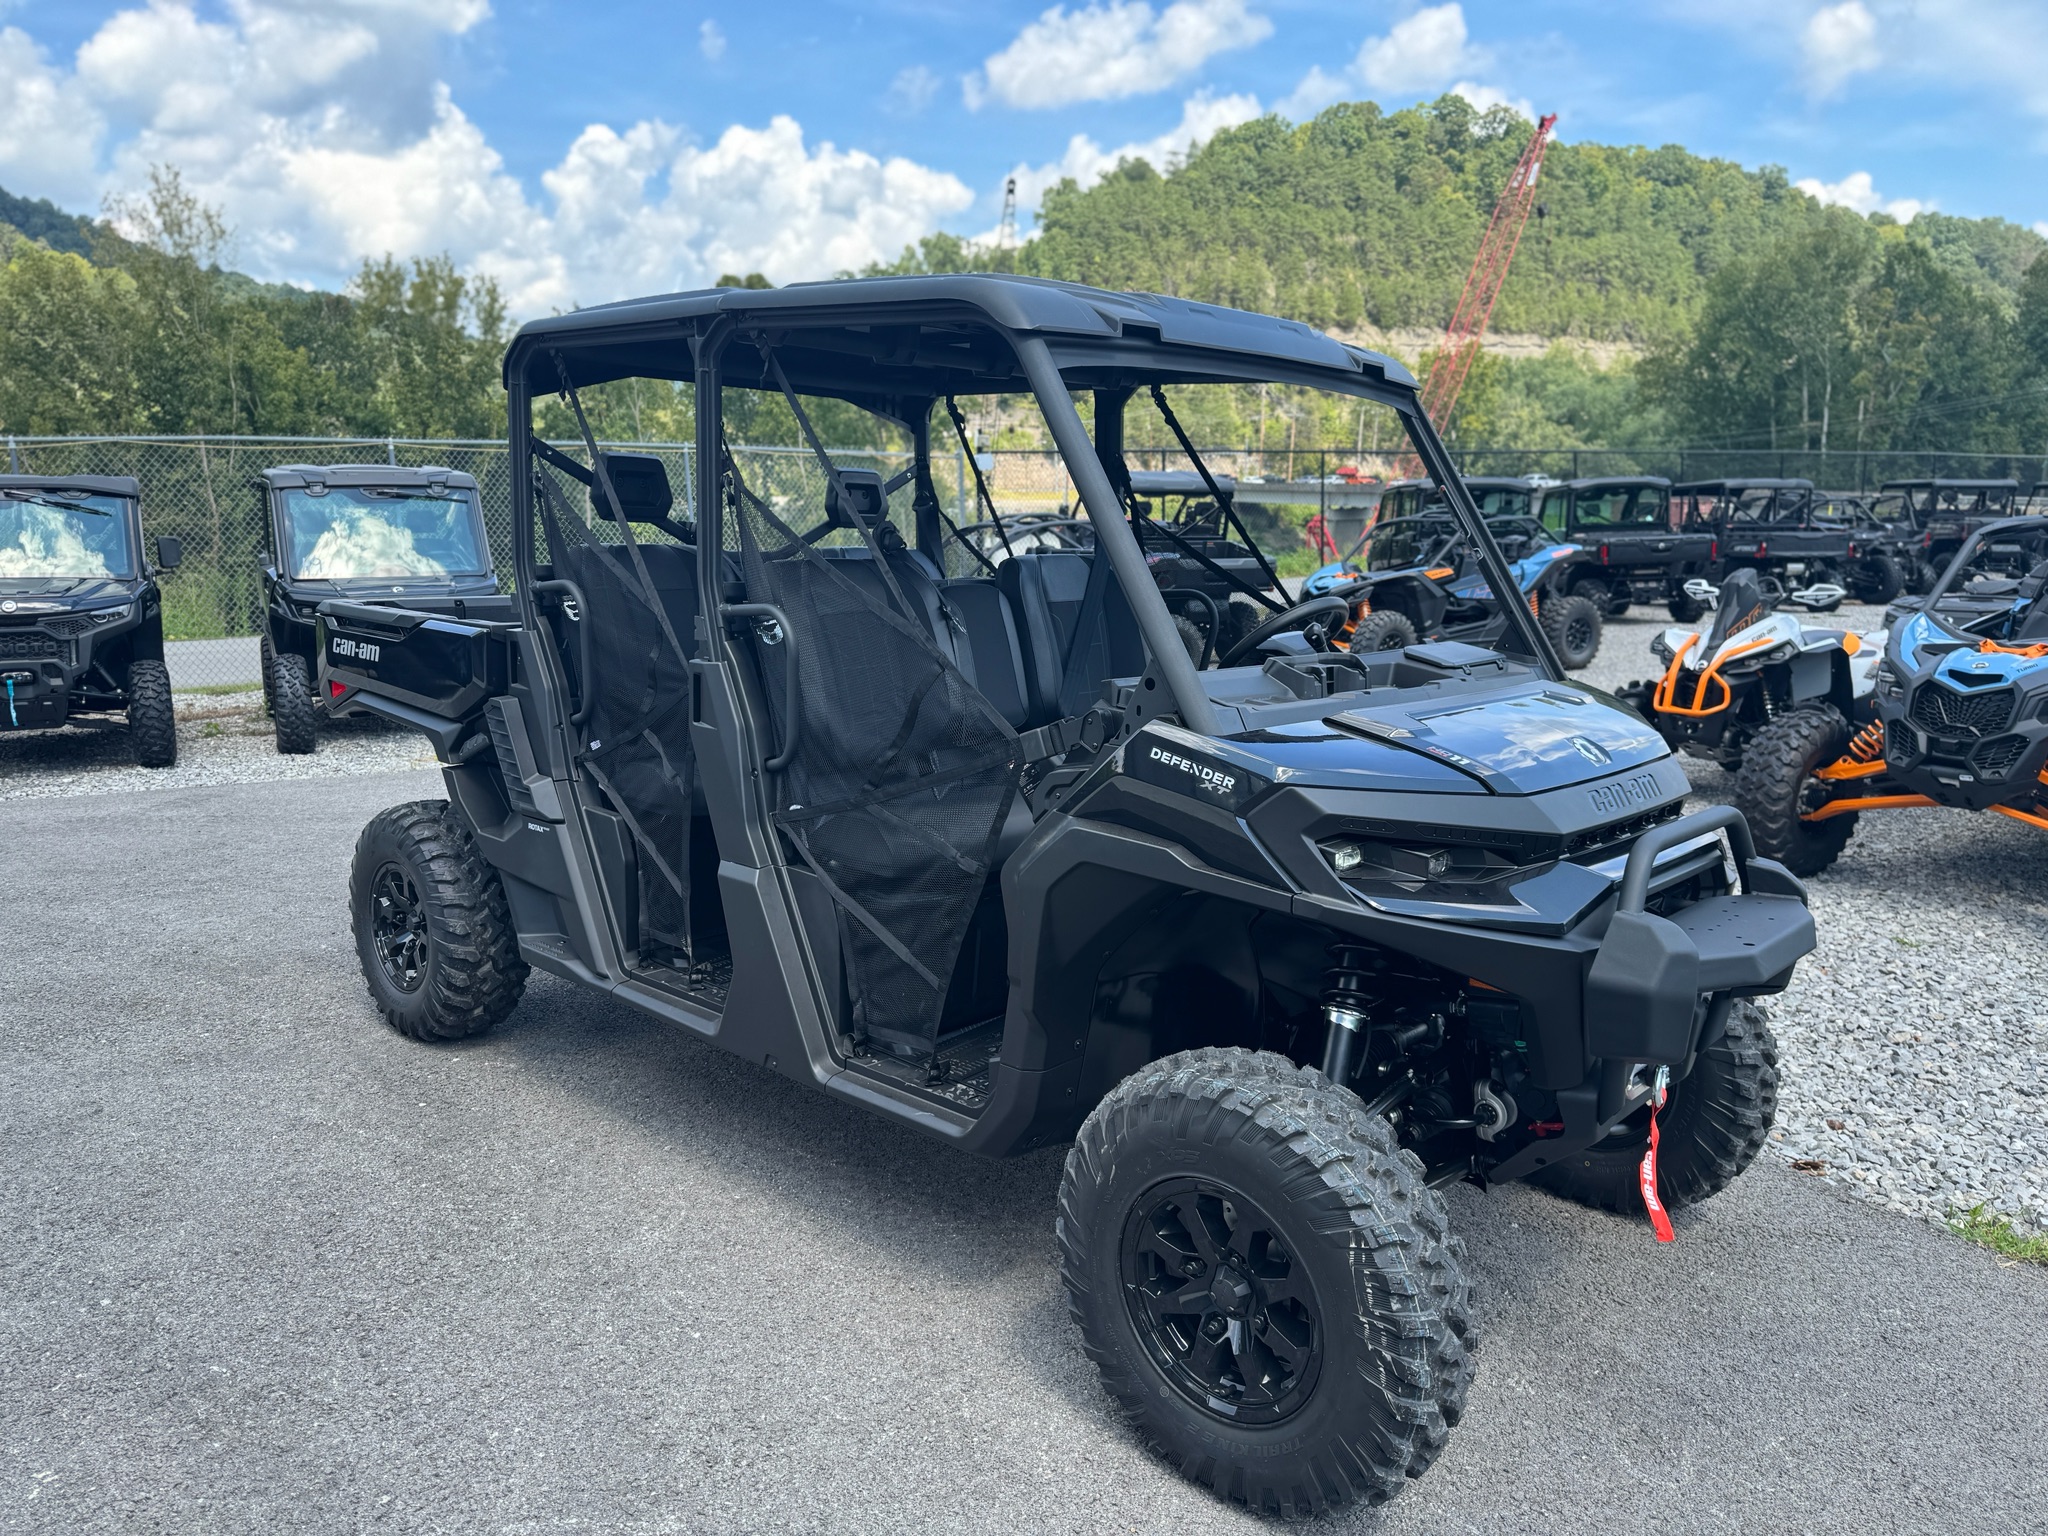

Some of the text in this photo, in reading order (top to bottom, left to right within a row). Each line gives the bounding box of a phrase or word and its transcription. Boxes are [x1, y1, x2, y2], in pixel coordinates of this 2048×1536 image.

[1150, 747, 1236, 789] DEFENDER
[1199, 780, 1231, 795] XT
[1587, 773, 1662, 815] can-am
[528, 822, 544, 833] ROTAX
[1643, 1150, 1660, 1211] can-am
[1252, 1432, 1304, 1459] TRAIL
